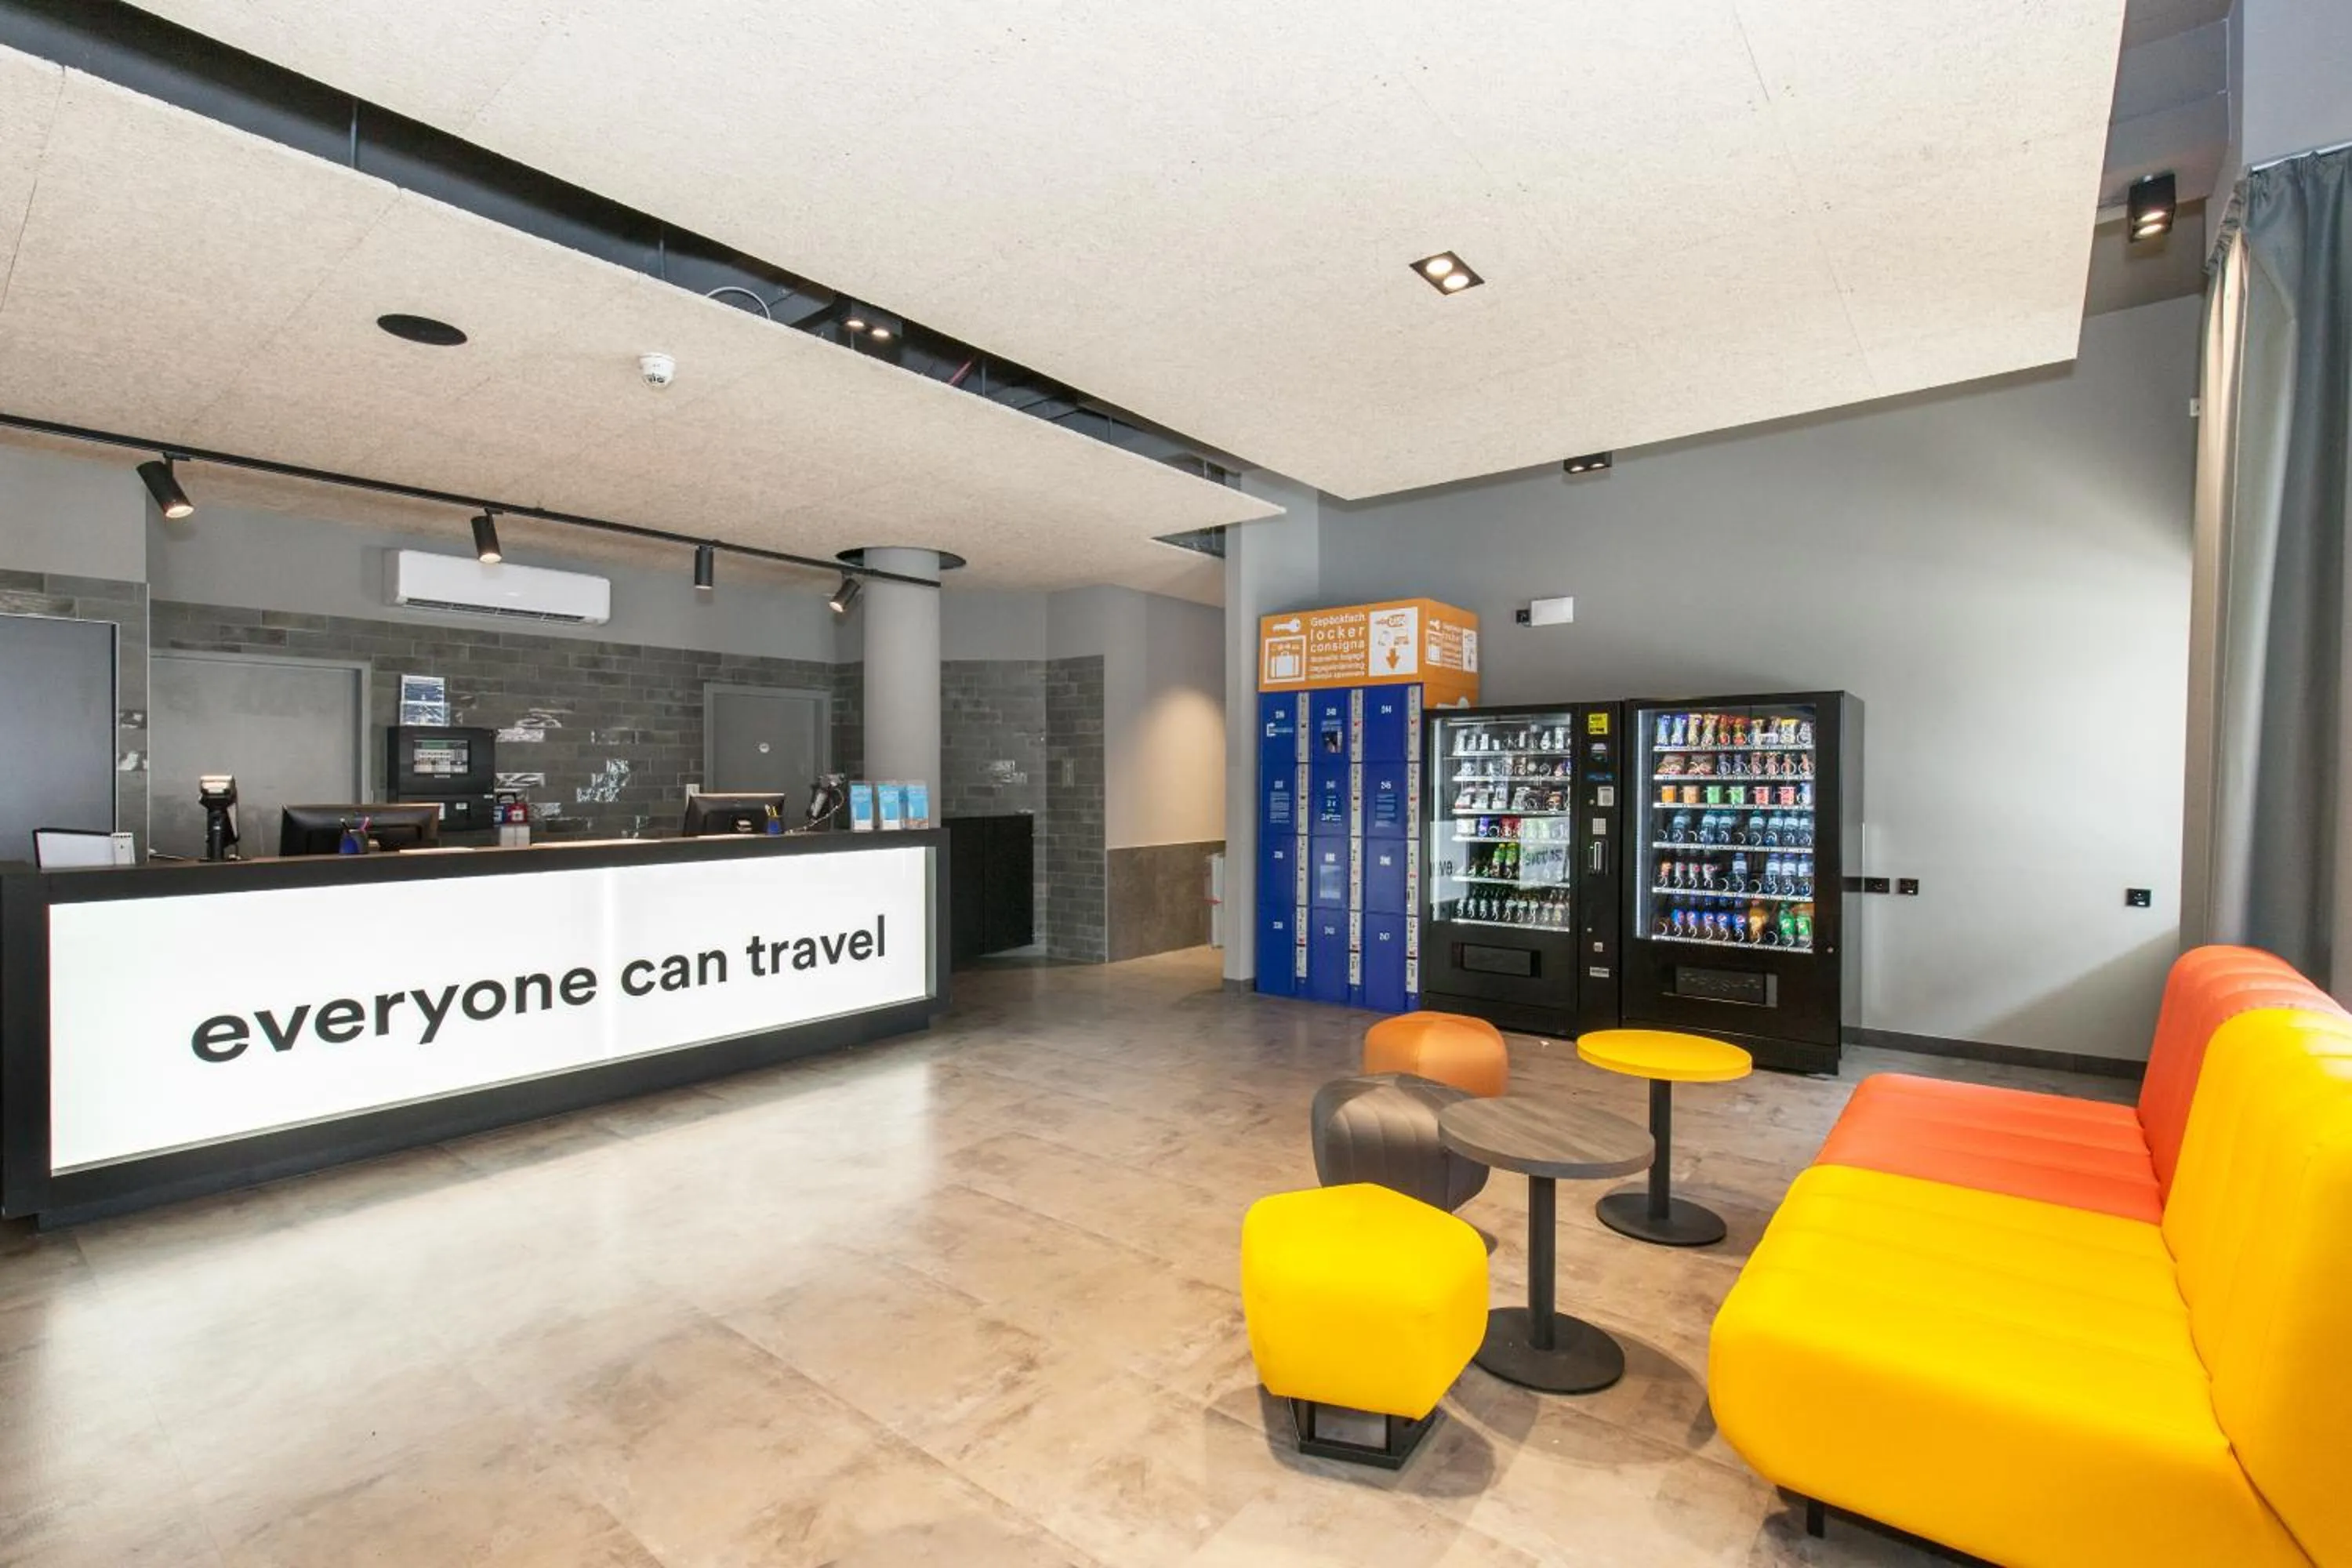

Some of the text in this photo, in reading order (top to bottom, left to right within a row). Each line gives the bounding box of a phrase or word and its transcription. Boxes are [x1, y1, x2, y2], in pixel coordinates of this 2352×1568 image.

[1310, 625, 1365, 641] locker
[1310, 639, 1365, 653] consigna
[192, 915, 886, 1063] everyone can travel
